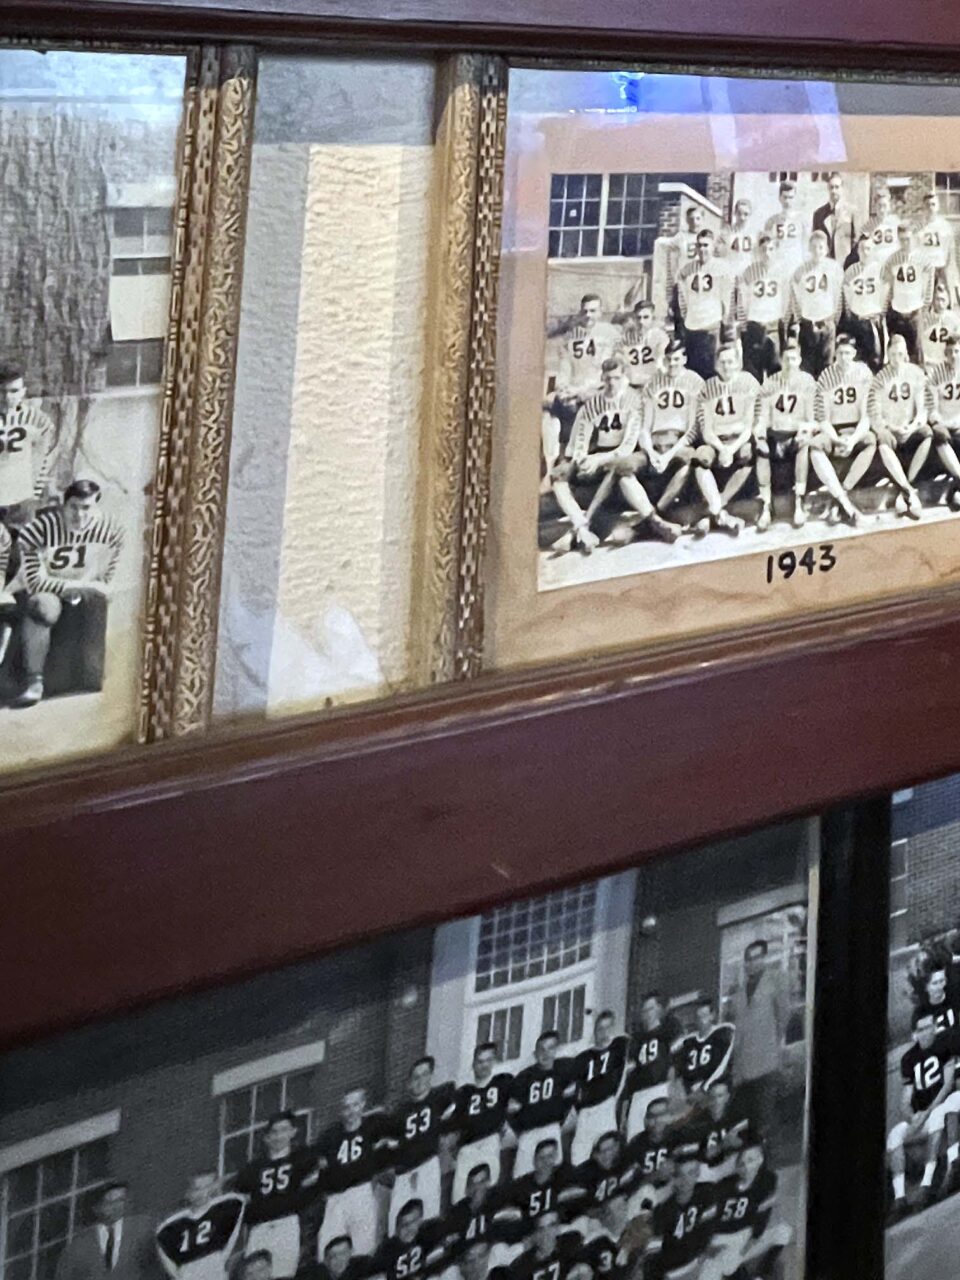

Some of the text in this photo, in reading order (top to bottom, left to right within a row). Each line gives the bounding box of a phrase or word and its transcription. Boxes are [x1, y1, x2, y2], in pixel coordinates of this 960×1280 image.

[775, 223, 797, 239] 52
[731, 237, 752, 252] 40
[691, 274, 713, 293] 43
[753, 281, 778, 298] 33
[572, 339, 596, 360] 54
[629, 345, 654, 366] 32
[657, 390, 685, 410] 30
[715, 396, 736, 417] 41
[775, 394, 798, 414] 47
[834, 387, 857, 406] 39
[599, 413, 622, 433] 44
[50, 546, 87, 570] 51
[767, 545, 837, 583] 1943
[638, 1039, 659, 1066] 49
[687, 1045, 712, 1070] 36
[587, 1052, 609, 1081] 17
[913, 1055, 942, 1091] 12
[468, 1086, 498, 1116] 29
[529, 1078, 553, 1104] 60
[405, 1108, 431, 1138] 53
[337, 1136, 363, 1164] 46
[260, 1164, 293, 1194] 55
[528, 1190, 551, 1216] 51
[721, 1197, 750, 1221] 58
[465, 1215, 486, 1240] 41
[674, 1207, 698, 1239] 43
[178, 1220, 212, 1253] 12
[396, 1247, 423, 1279] 52
